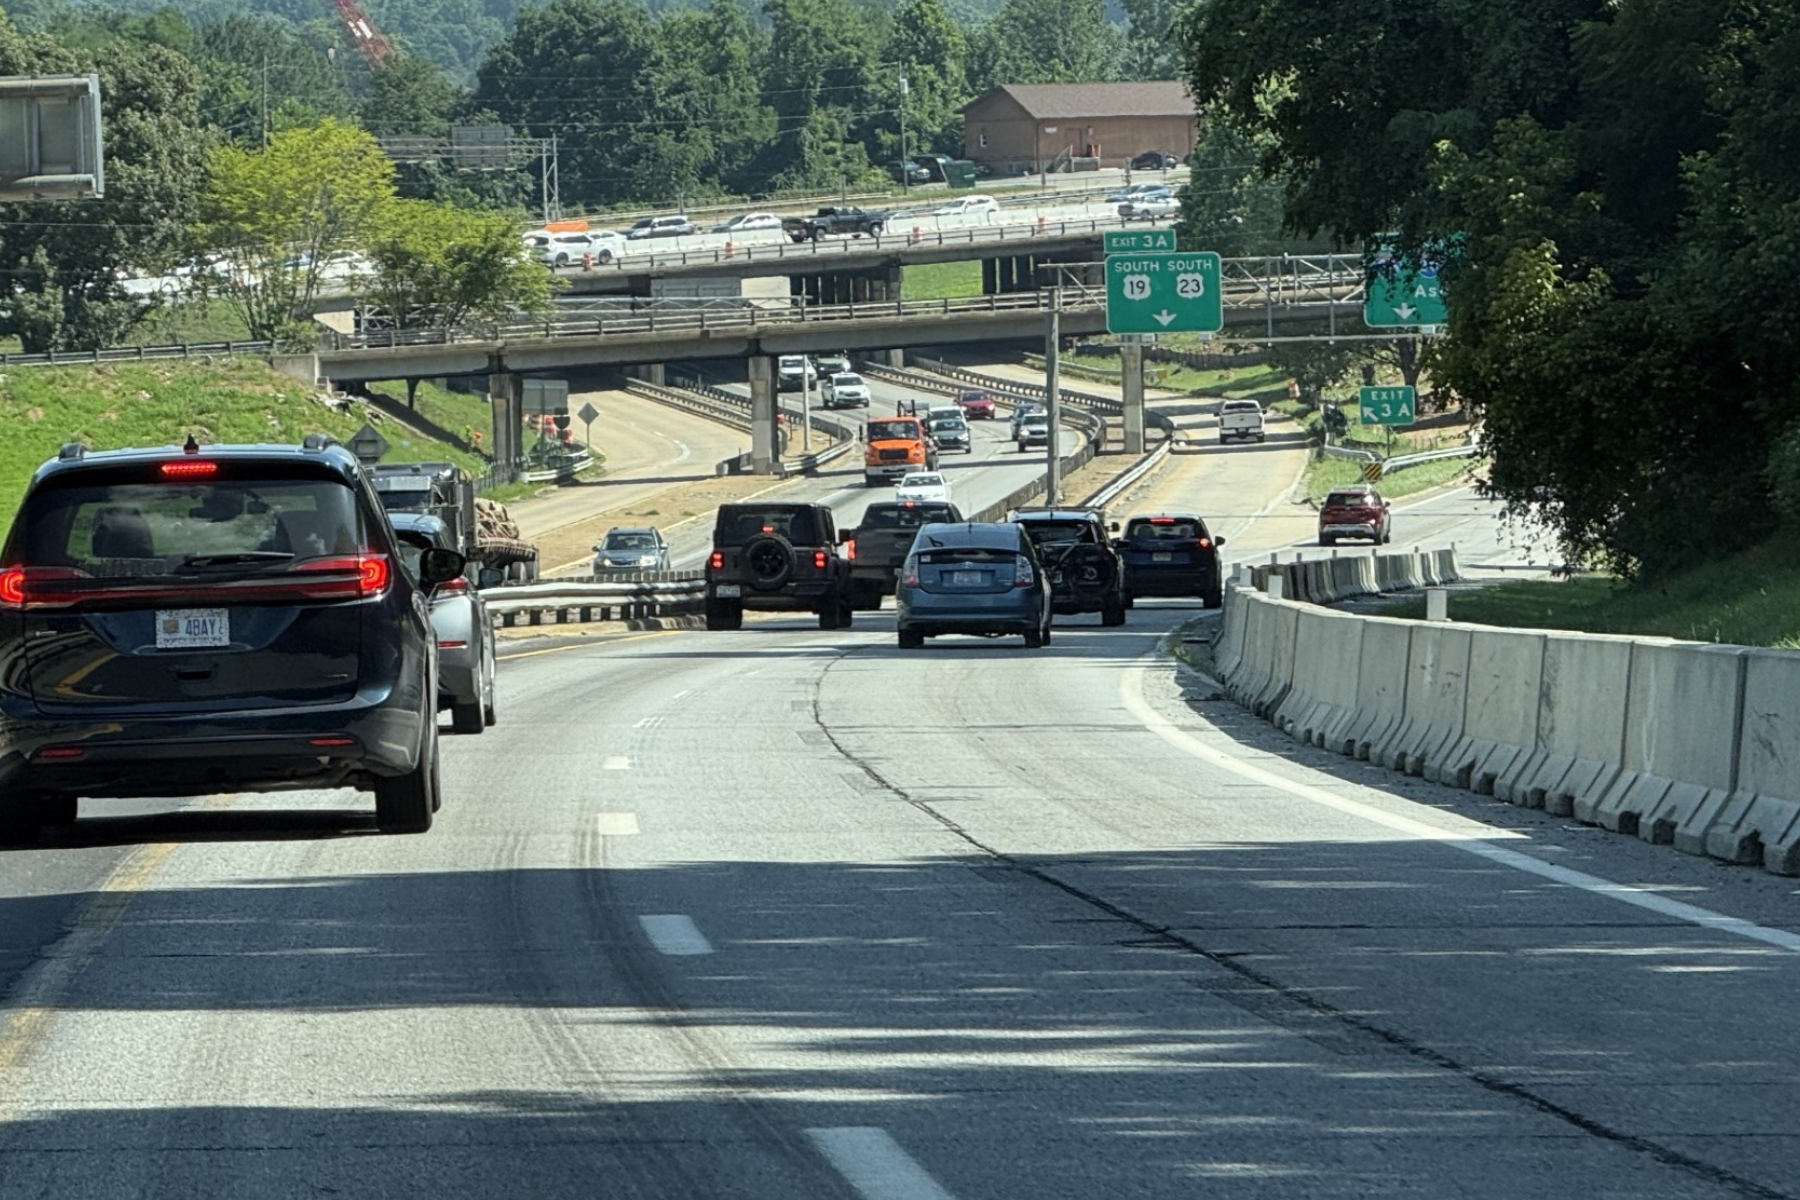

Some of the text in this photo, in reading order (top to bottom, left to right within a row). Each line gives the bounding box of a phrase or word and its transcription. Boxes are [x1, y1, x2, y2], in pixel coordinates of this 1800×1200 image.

[1112, 237, 1137, 248] EXIT
[1114, 259, 1213, 273] SOUTH SOUTH
[1129, 278, 1201, 296] 19 23
[1371, 390, 1405, 401] EXIT
